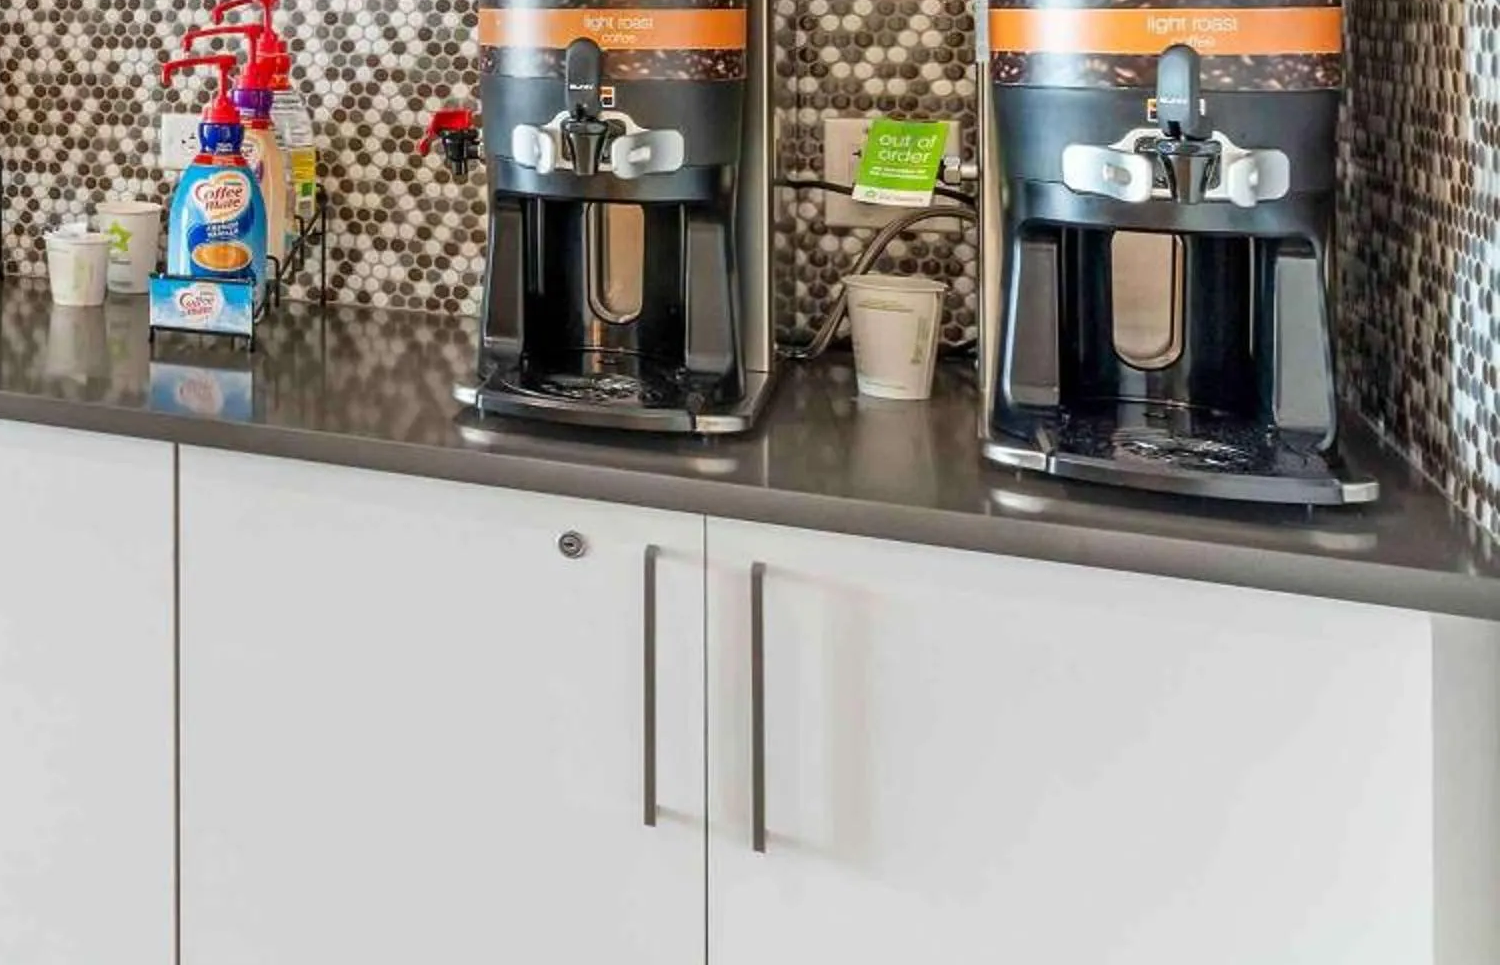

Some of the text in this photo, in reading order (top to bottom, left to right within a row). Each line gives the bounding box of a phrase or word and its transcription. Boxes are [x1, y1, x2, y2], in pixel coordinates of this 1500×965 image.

[1146, 15, 1238, 35] light roast
[877, 148, 932, 164] order
